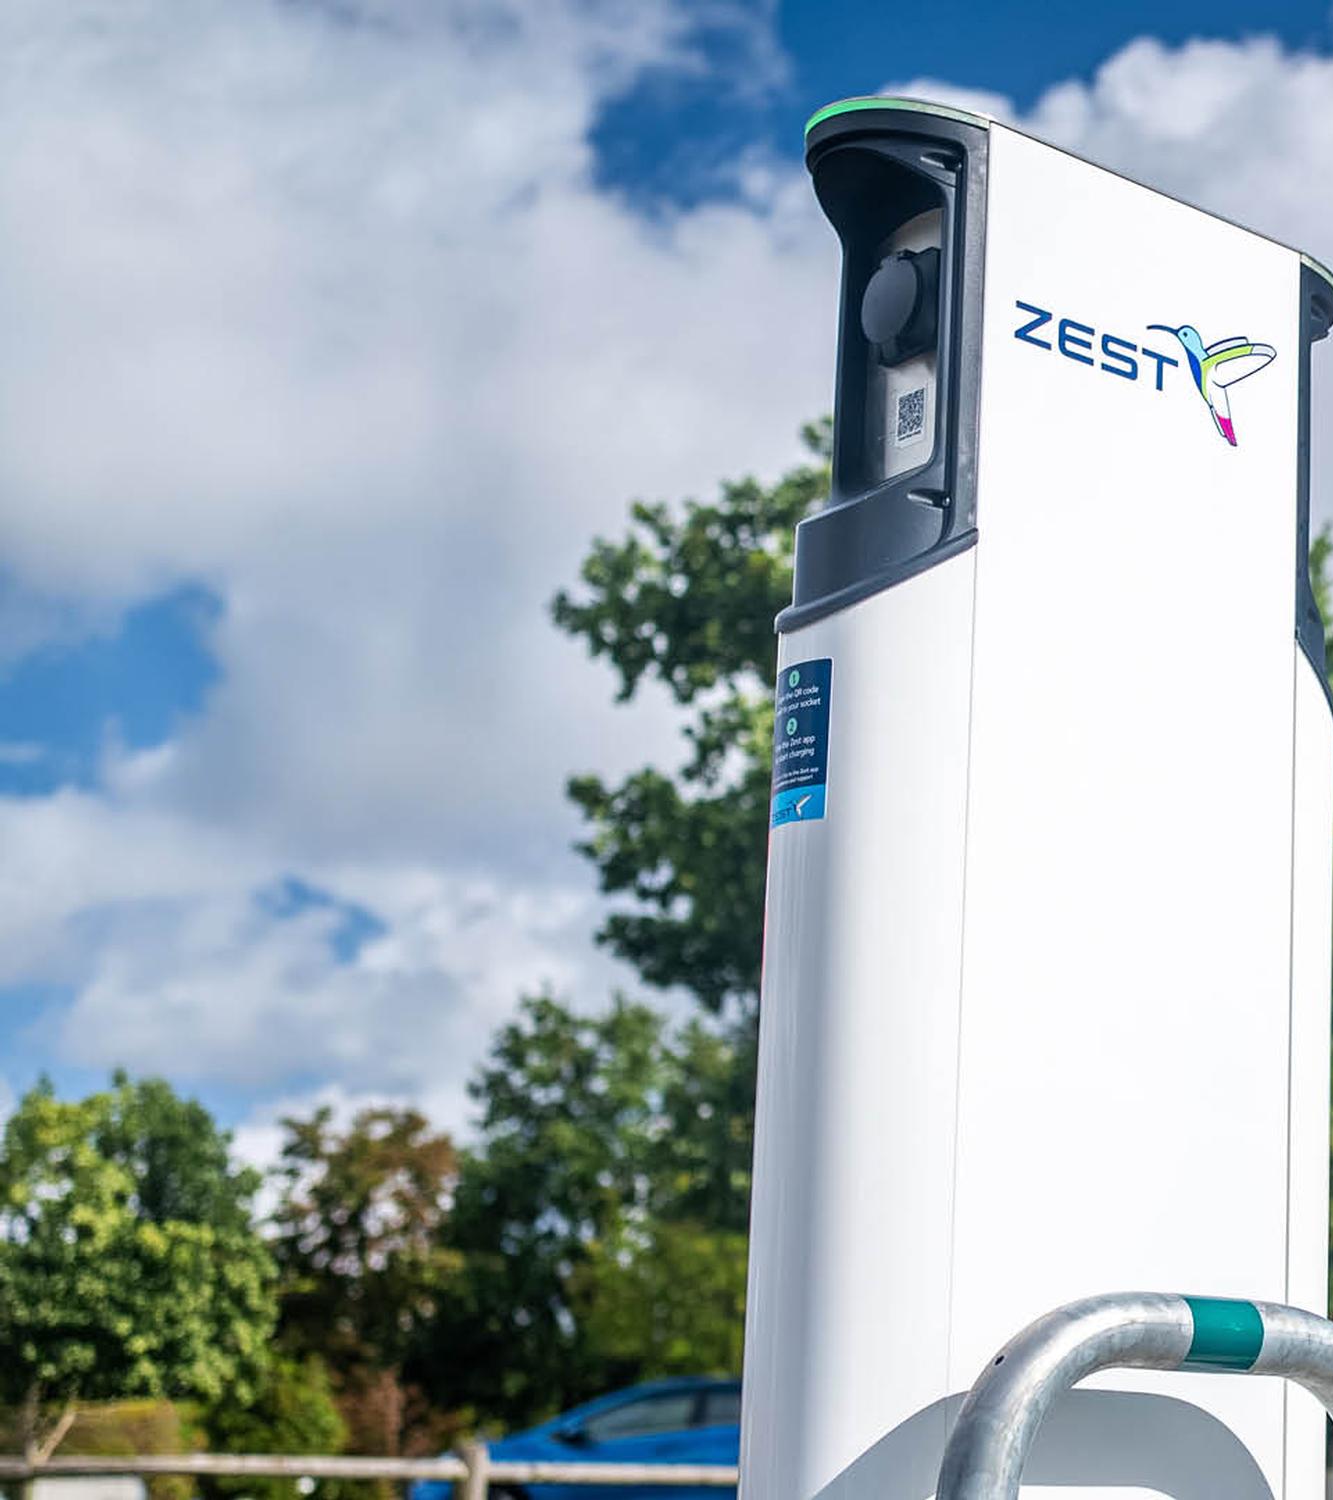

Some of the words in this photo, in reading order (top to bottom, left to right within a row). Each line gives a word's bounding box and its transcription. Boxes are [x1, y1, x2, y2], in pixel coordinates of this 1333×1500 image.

[1014, 300, 1179, 392] ZEST
[794, 688, 802, 698] QR
[803, 684, 819, 695] code
[800, 697, 821, 708] socket
[803, 736, 815, 745] app
[789, 747, 815, 759] charging
